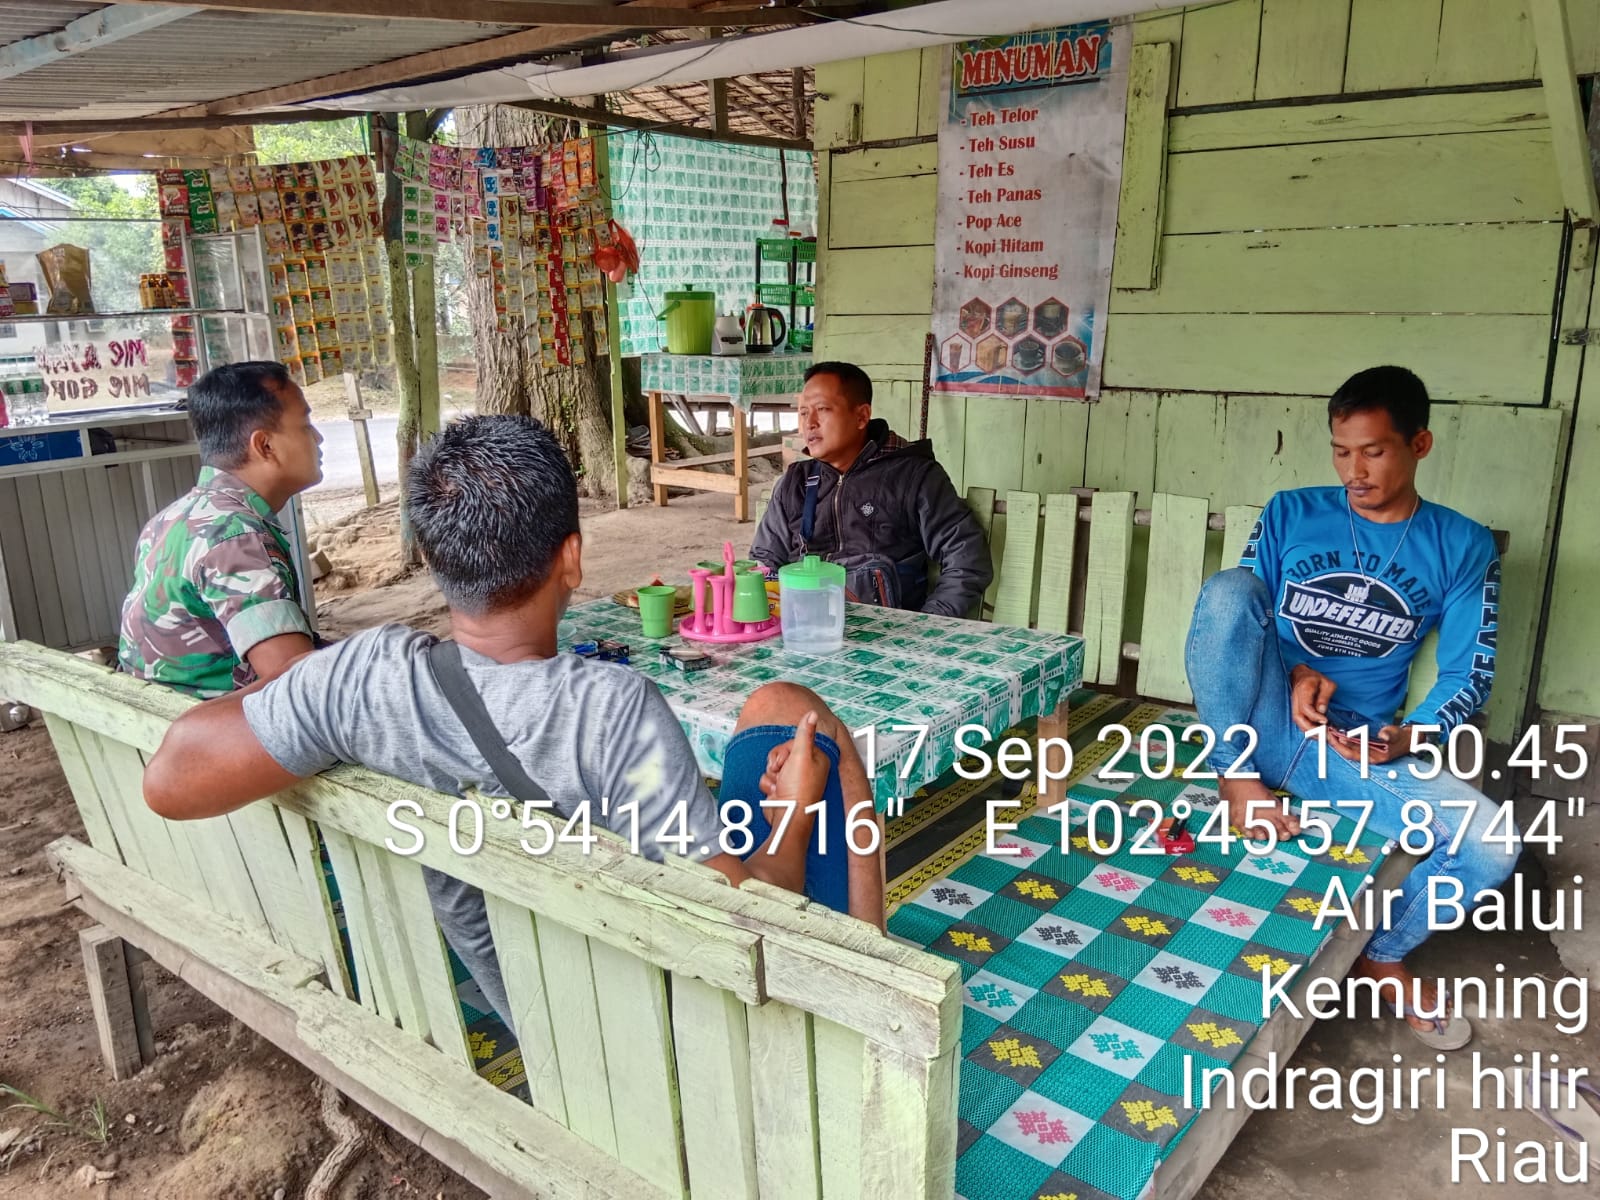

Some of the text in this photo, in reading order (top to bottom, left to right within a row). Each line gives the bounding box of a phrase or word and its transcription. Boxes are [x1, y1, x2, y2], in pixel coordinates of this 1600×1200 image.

[961, 36, 1101, 88] MINUMAN
[970, 107, 1039, 127] Teh Telor
[969, 135, 1036, 153] Teh Susu
[968, 161, 1015, 178] Teh Es
[968, 187, 1042, 204] Teh Panas
[966, 213, 1022, 231] Pop Ace
[965, 238, 1044, 256] Kopi Hitam
[964, 264, 1059, 281] Kopi Ginseng
[1352, 550, 1381, 573] TO
[1384, 562, 1432, 614] MADE
[1288, 591, 1415, 640] UNDEFEATED
